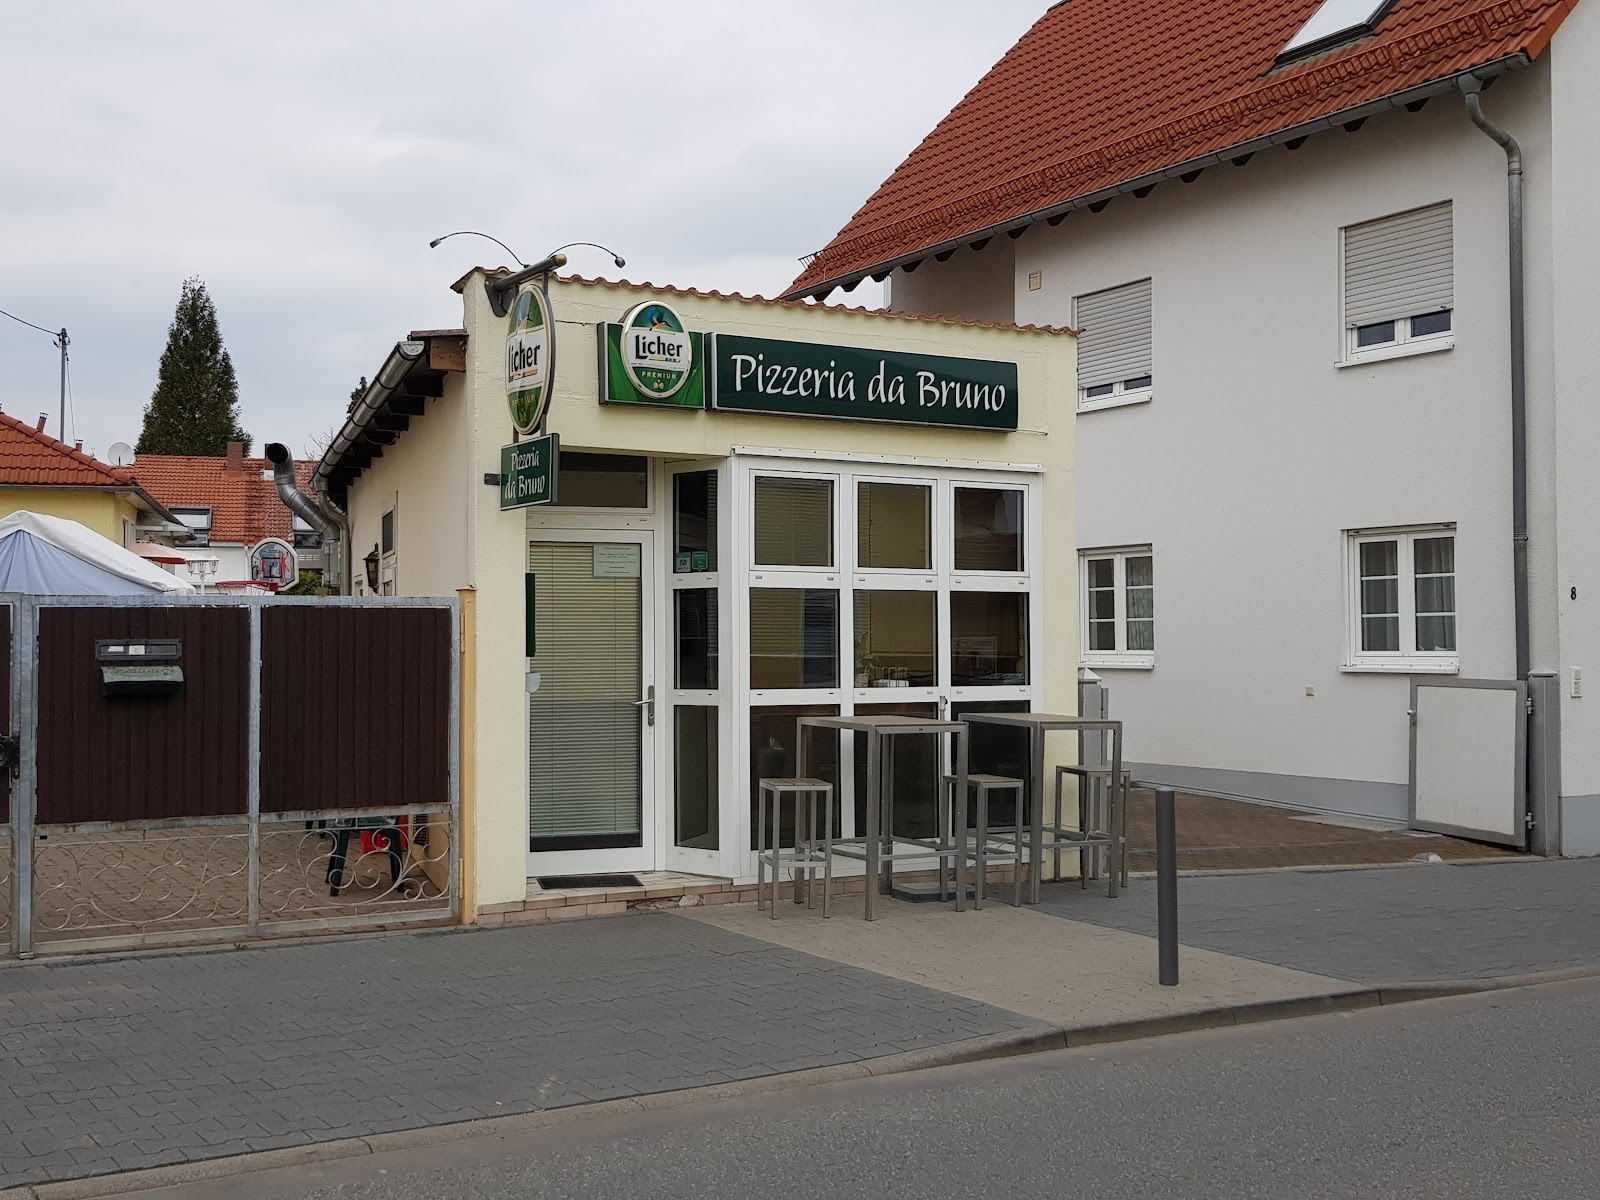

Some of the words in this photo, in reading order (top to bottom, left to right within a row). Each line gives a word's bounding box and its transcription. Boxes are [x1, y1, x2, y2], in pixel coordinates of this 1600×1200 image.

[635, 334, 683, 359] Licher
[509, 339, 541, 383] Licher
[641, 371, 677, 380] PREMIUM
[731, 353, 856, 402] Pizzeria
[867, 359, 906, 406] da
[916, 371, 1006, 412] Bruno
[511, 446, 539, 472] Pizzeria
[505, 472, 516, 500] da
[518, 474, 546, 498] Bruno
[1570, 586, 1577, 600] 8
